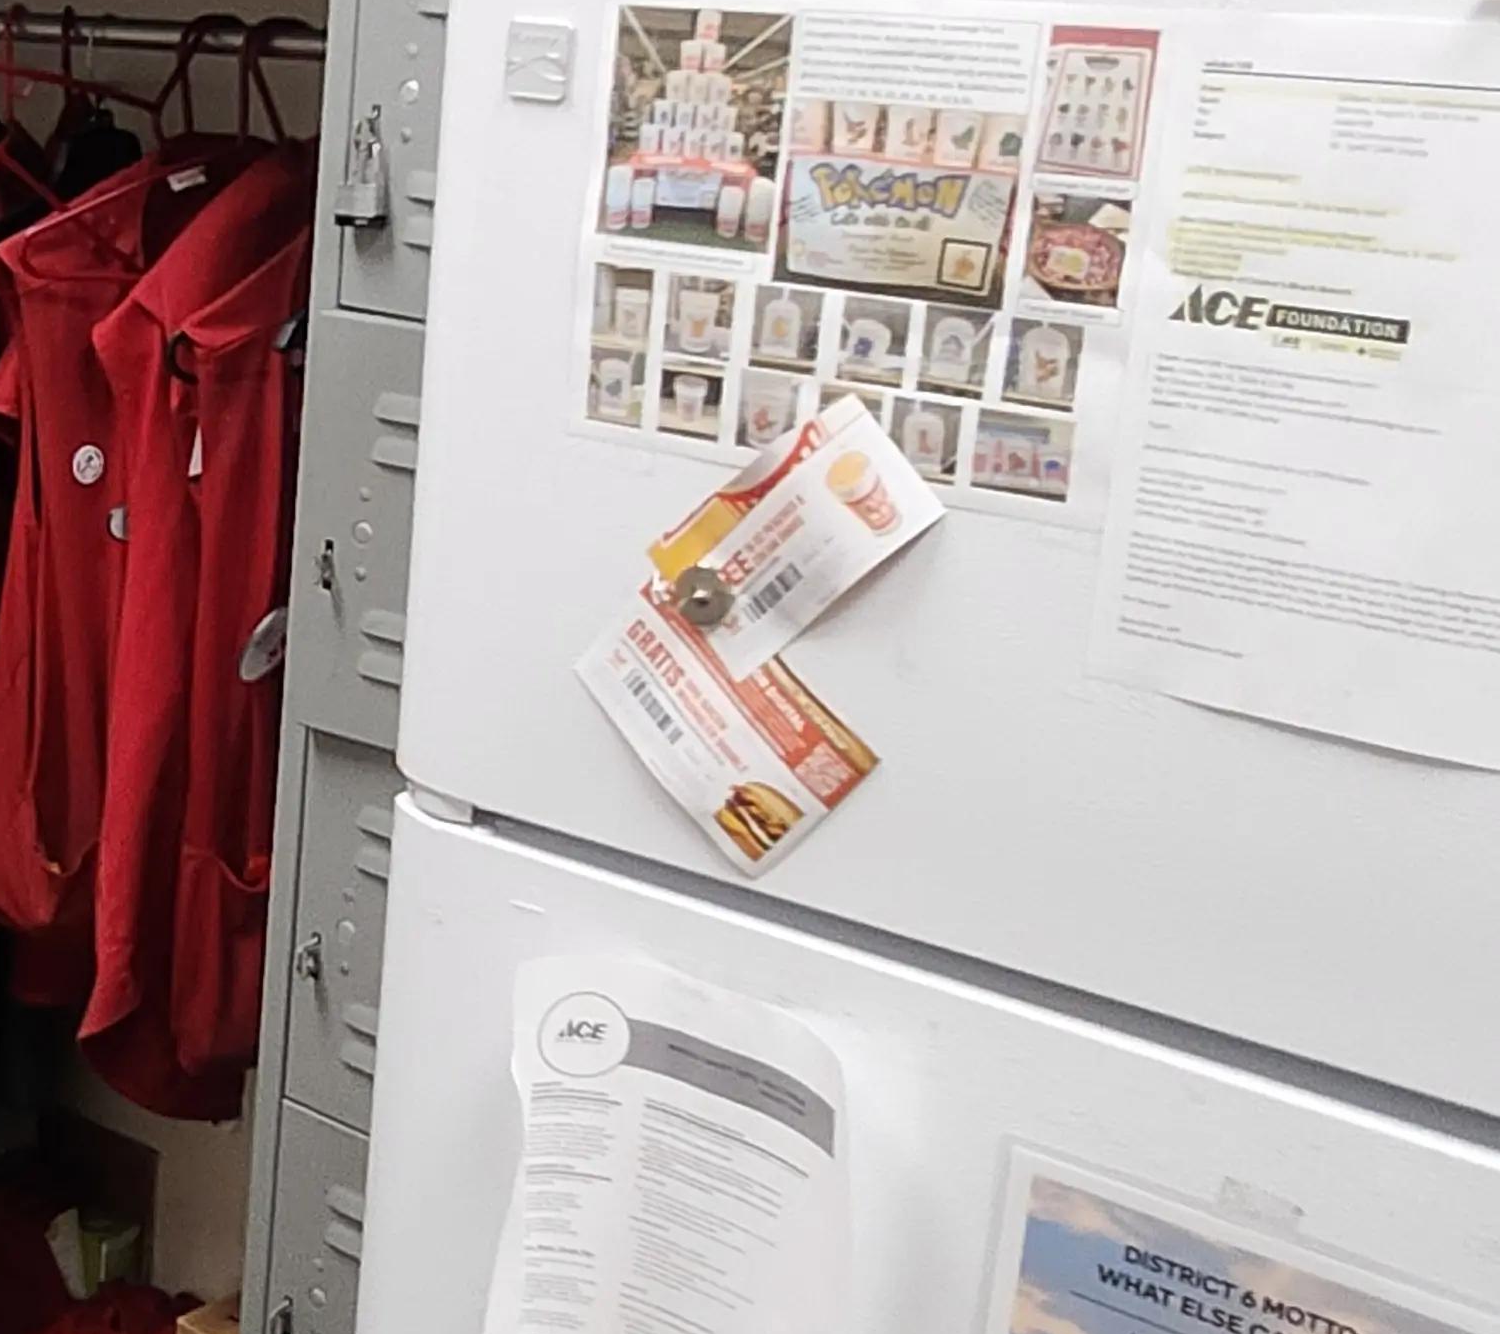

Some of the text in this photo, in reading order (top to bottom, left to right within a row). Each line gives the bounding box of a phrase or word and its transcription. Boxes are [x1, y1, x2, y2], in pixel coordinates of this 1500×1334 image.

[1168, 284, 1401, 340] ACE FOUNDATION
[626, 619, 685, 688] GRATIS
[559, 1019, 608, 1040] ACE
[1097, 1263, 1174, 1307] WHAT
[1181, 1296, 1244, 1334] ELSE
[1124, 1245, 1238, 1300] DISTRICT
[1240, 1291, 1256, 1309] 6
